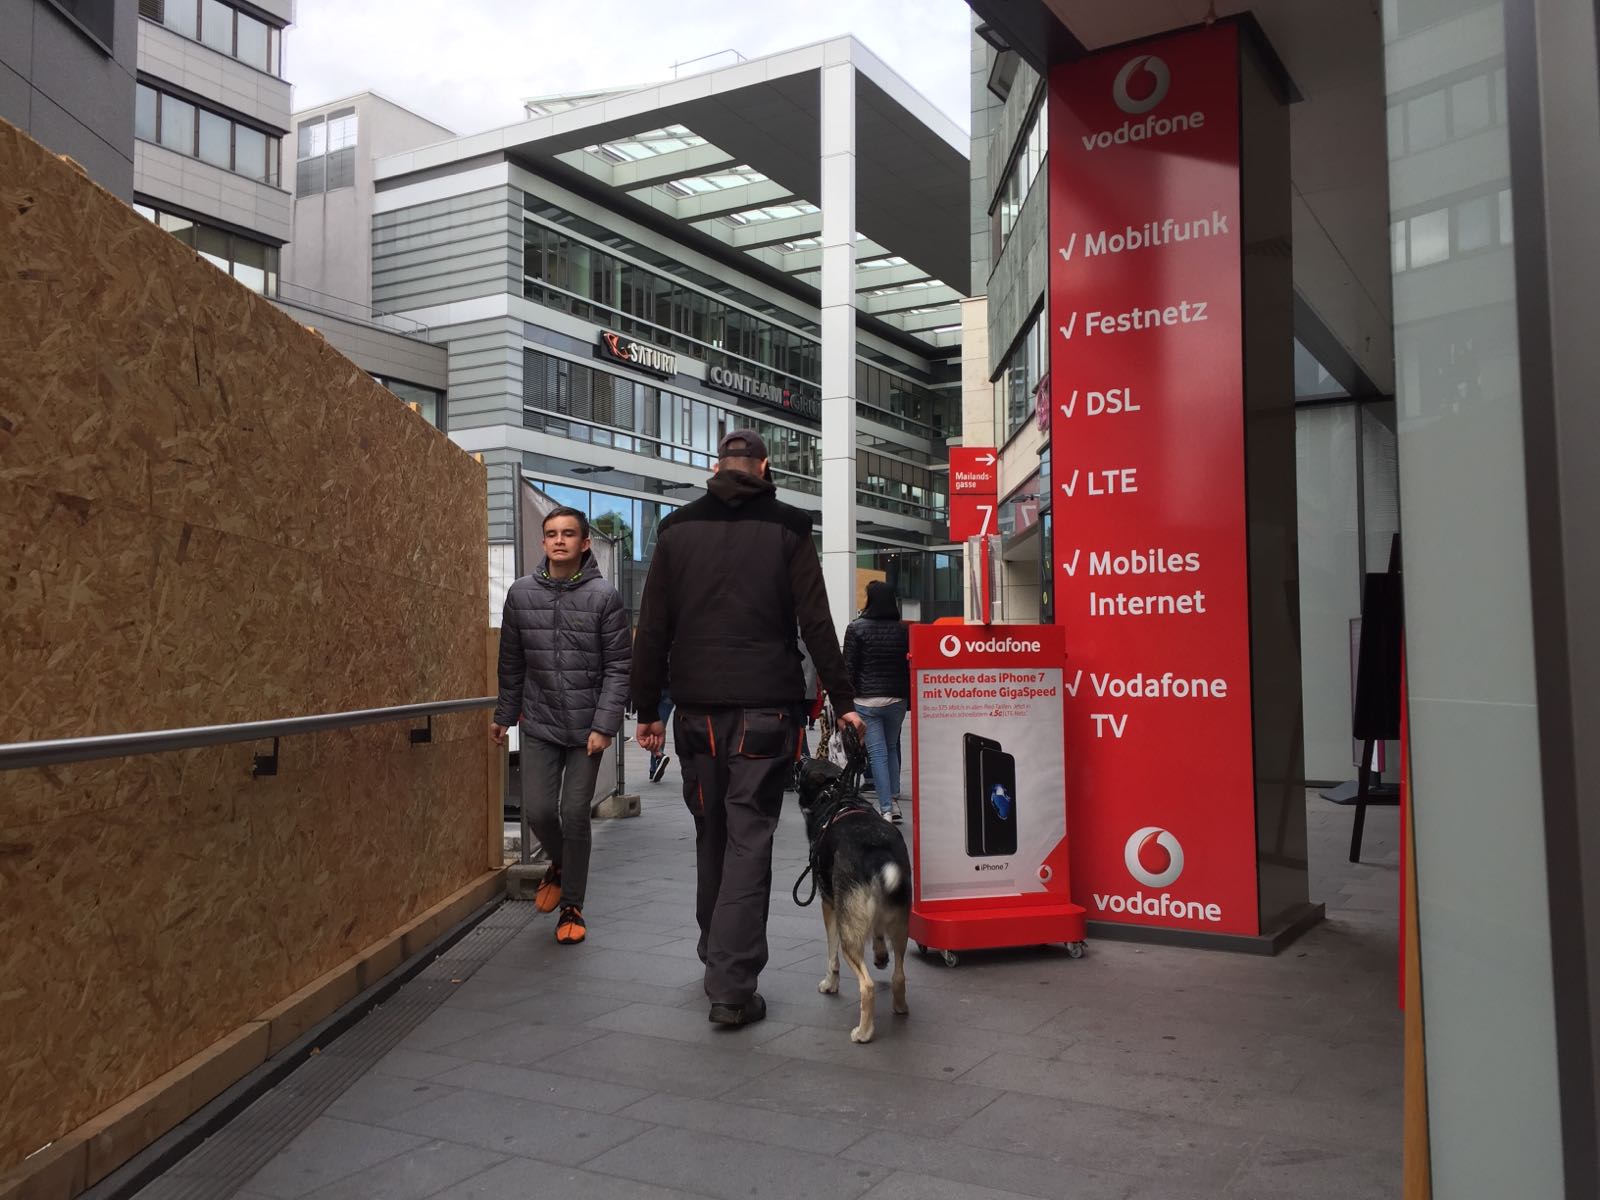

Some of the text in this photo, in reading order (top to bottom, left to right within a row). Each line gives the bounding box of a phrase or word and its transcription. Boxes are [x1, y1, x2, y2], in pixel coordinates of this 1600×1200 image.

[1082, 111, 1204, 150] vodafone
[1084, 210, 1229, 257] Mobilfunk
[1085, 300, 1208, 336] Festnetz
[629, 342, 678, 375] SATURN
[1086, 387, 1140, 416] DSL
[955, 471, 992, 480] Mailands-
[955, 481, 977, 490] gasse
[1088, 468, 1138, 495] LTE
[976, 505, 993, 536] 7
[1089, 548, 1200, 576] Mobiles
[1090, 590, 1206, 616] Internet
[965, 637, 1041, 653] vodafone
[923, 672, 1045, 684] Entdecke das iPhone 7
[1090, 672, 1228, 698] Vodafone
[923, 686, 1056, 700] mit Vodafone GigaSpeed
[1090, 714, 1128, 738] TV
[980, 862, 1009, 871] iPhone 7
[1093, 891, 1222, 922] vodafone
